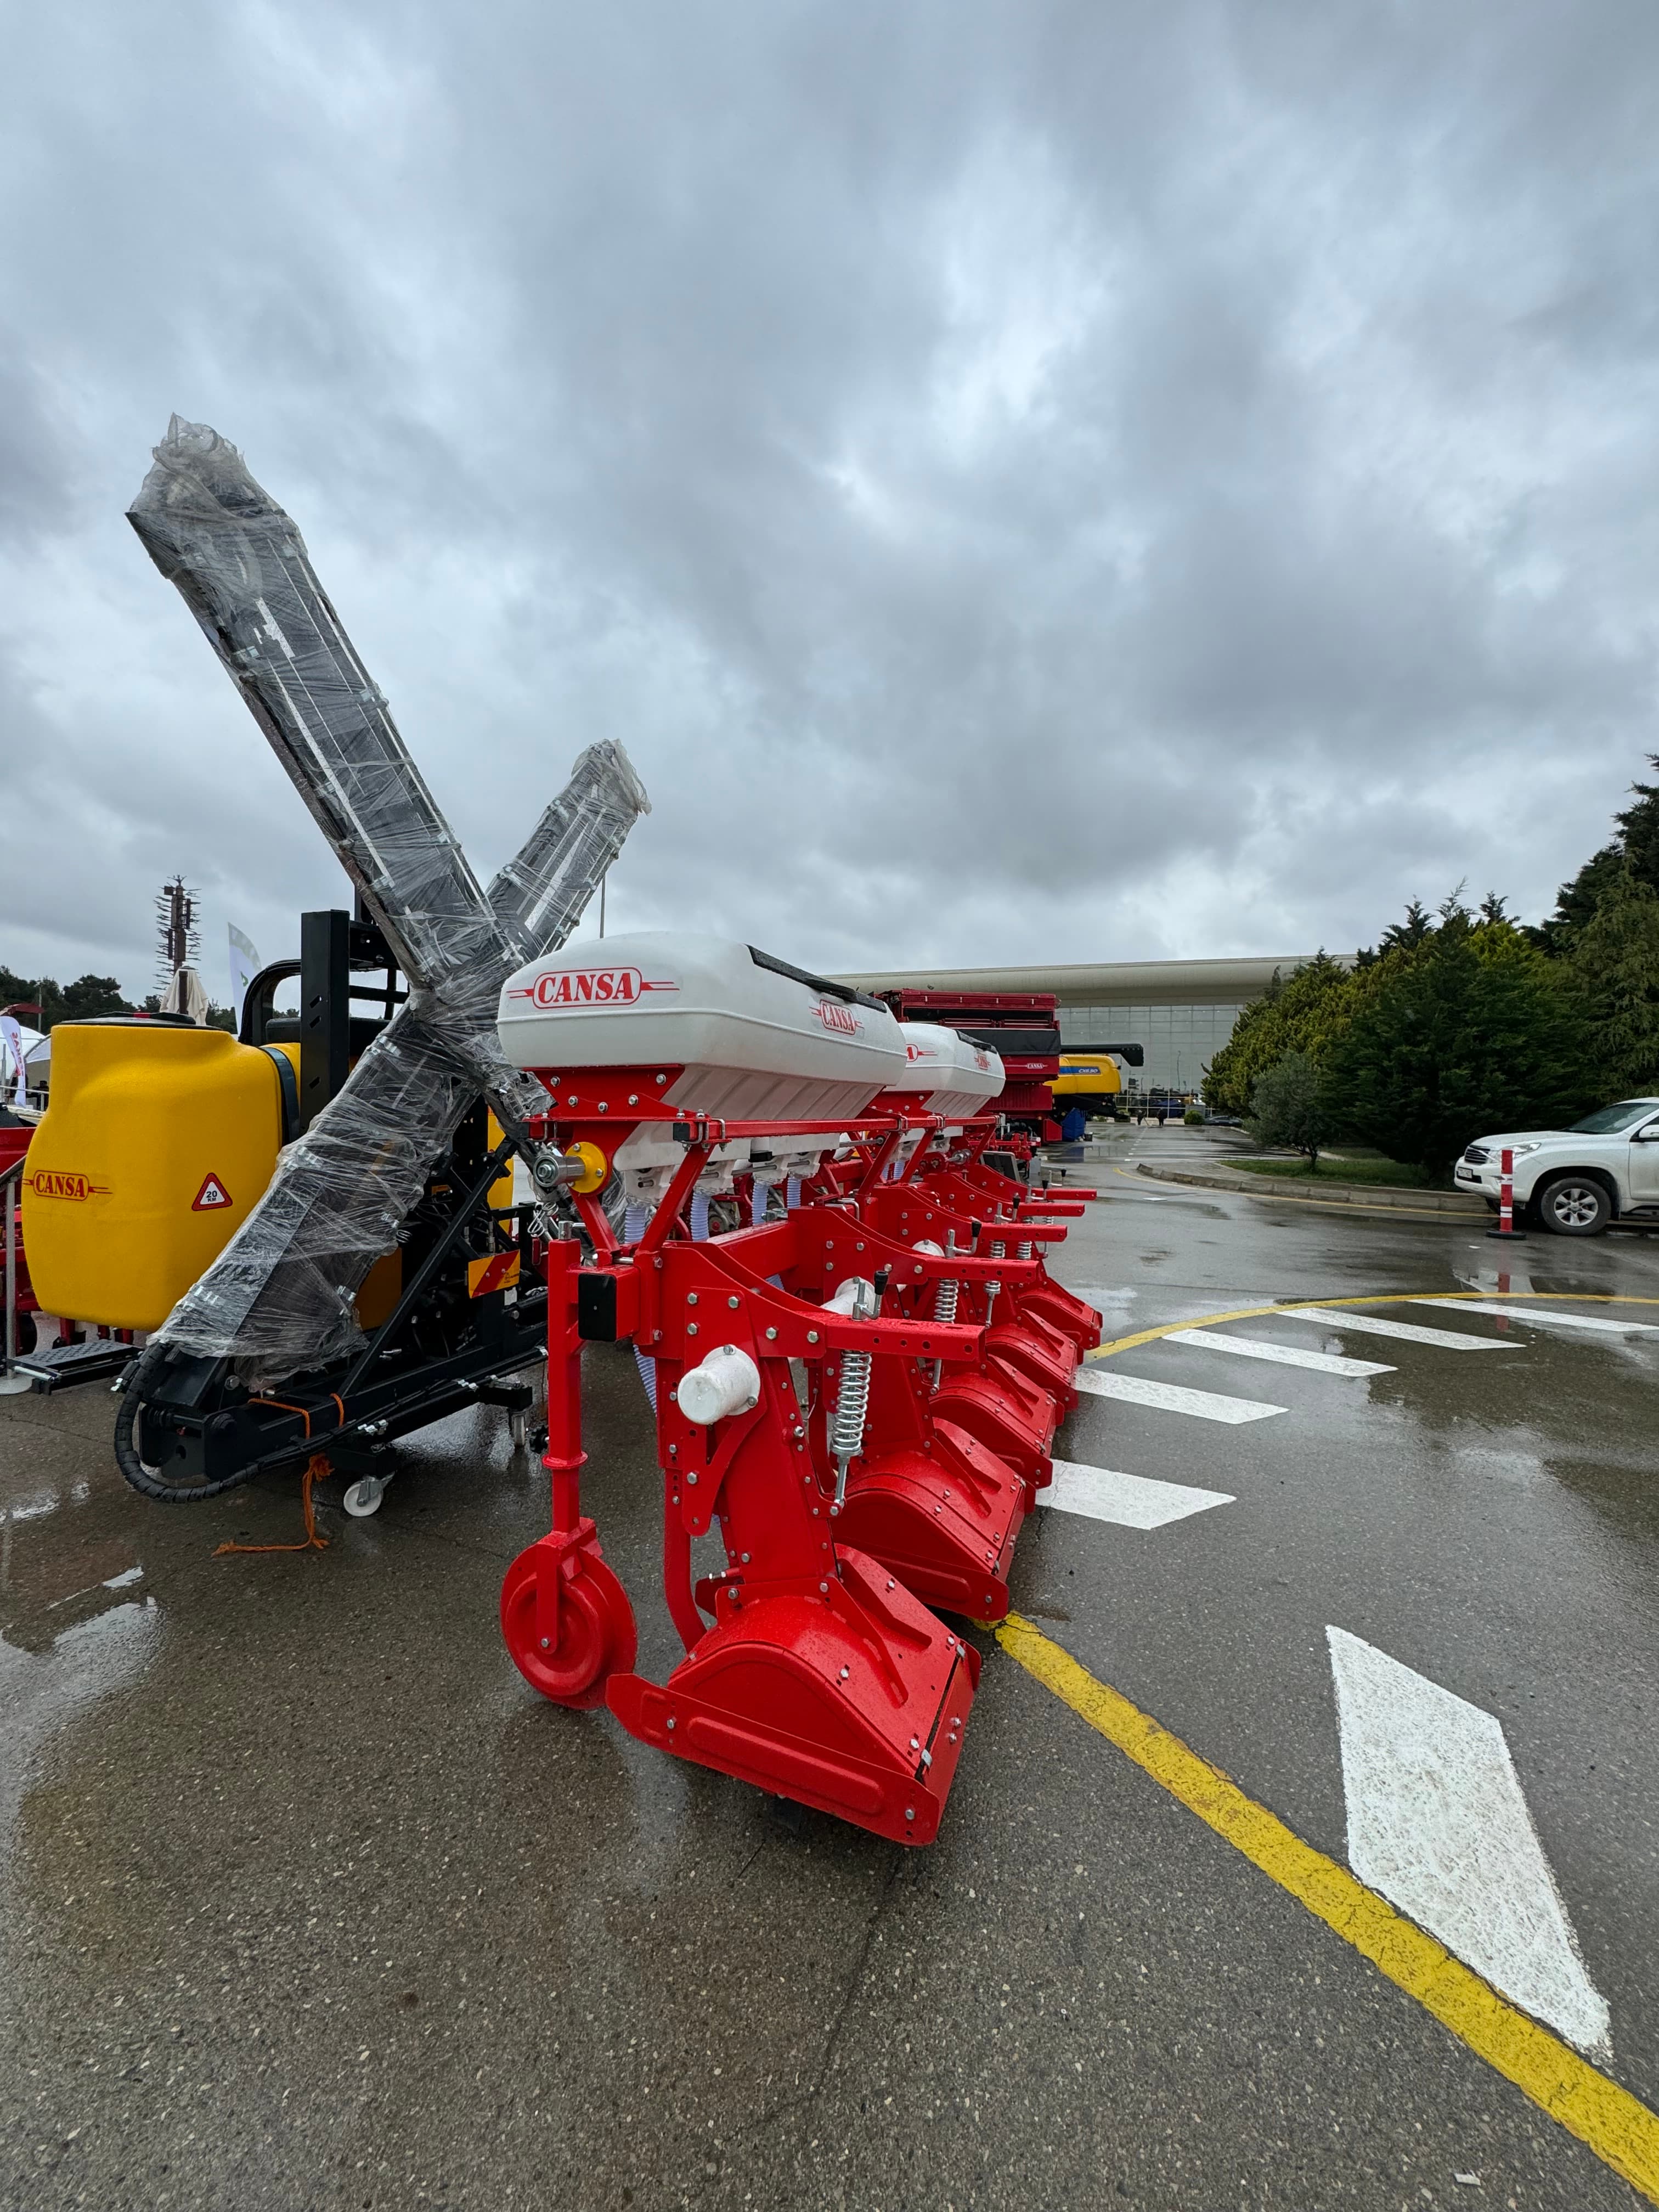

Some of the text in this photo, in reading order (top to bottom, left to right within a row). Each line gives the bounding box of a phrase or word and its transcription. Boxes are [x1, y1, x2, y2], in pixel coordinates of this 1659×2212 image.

[538, 972, 634, 1003] CANSA
[822, 1003, 855, 1031] CANSA
[36, 1173, 86, 1197] CANSA
